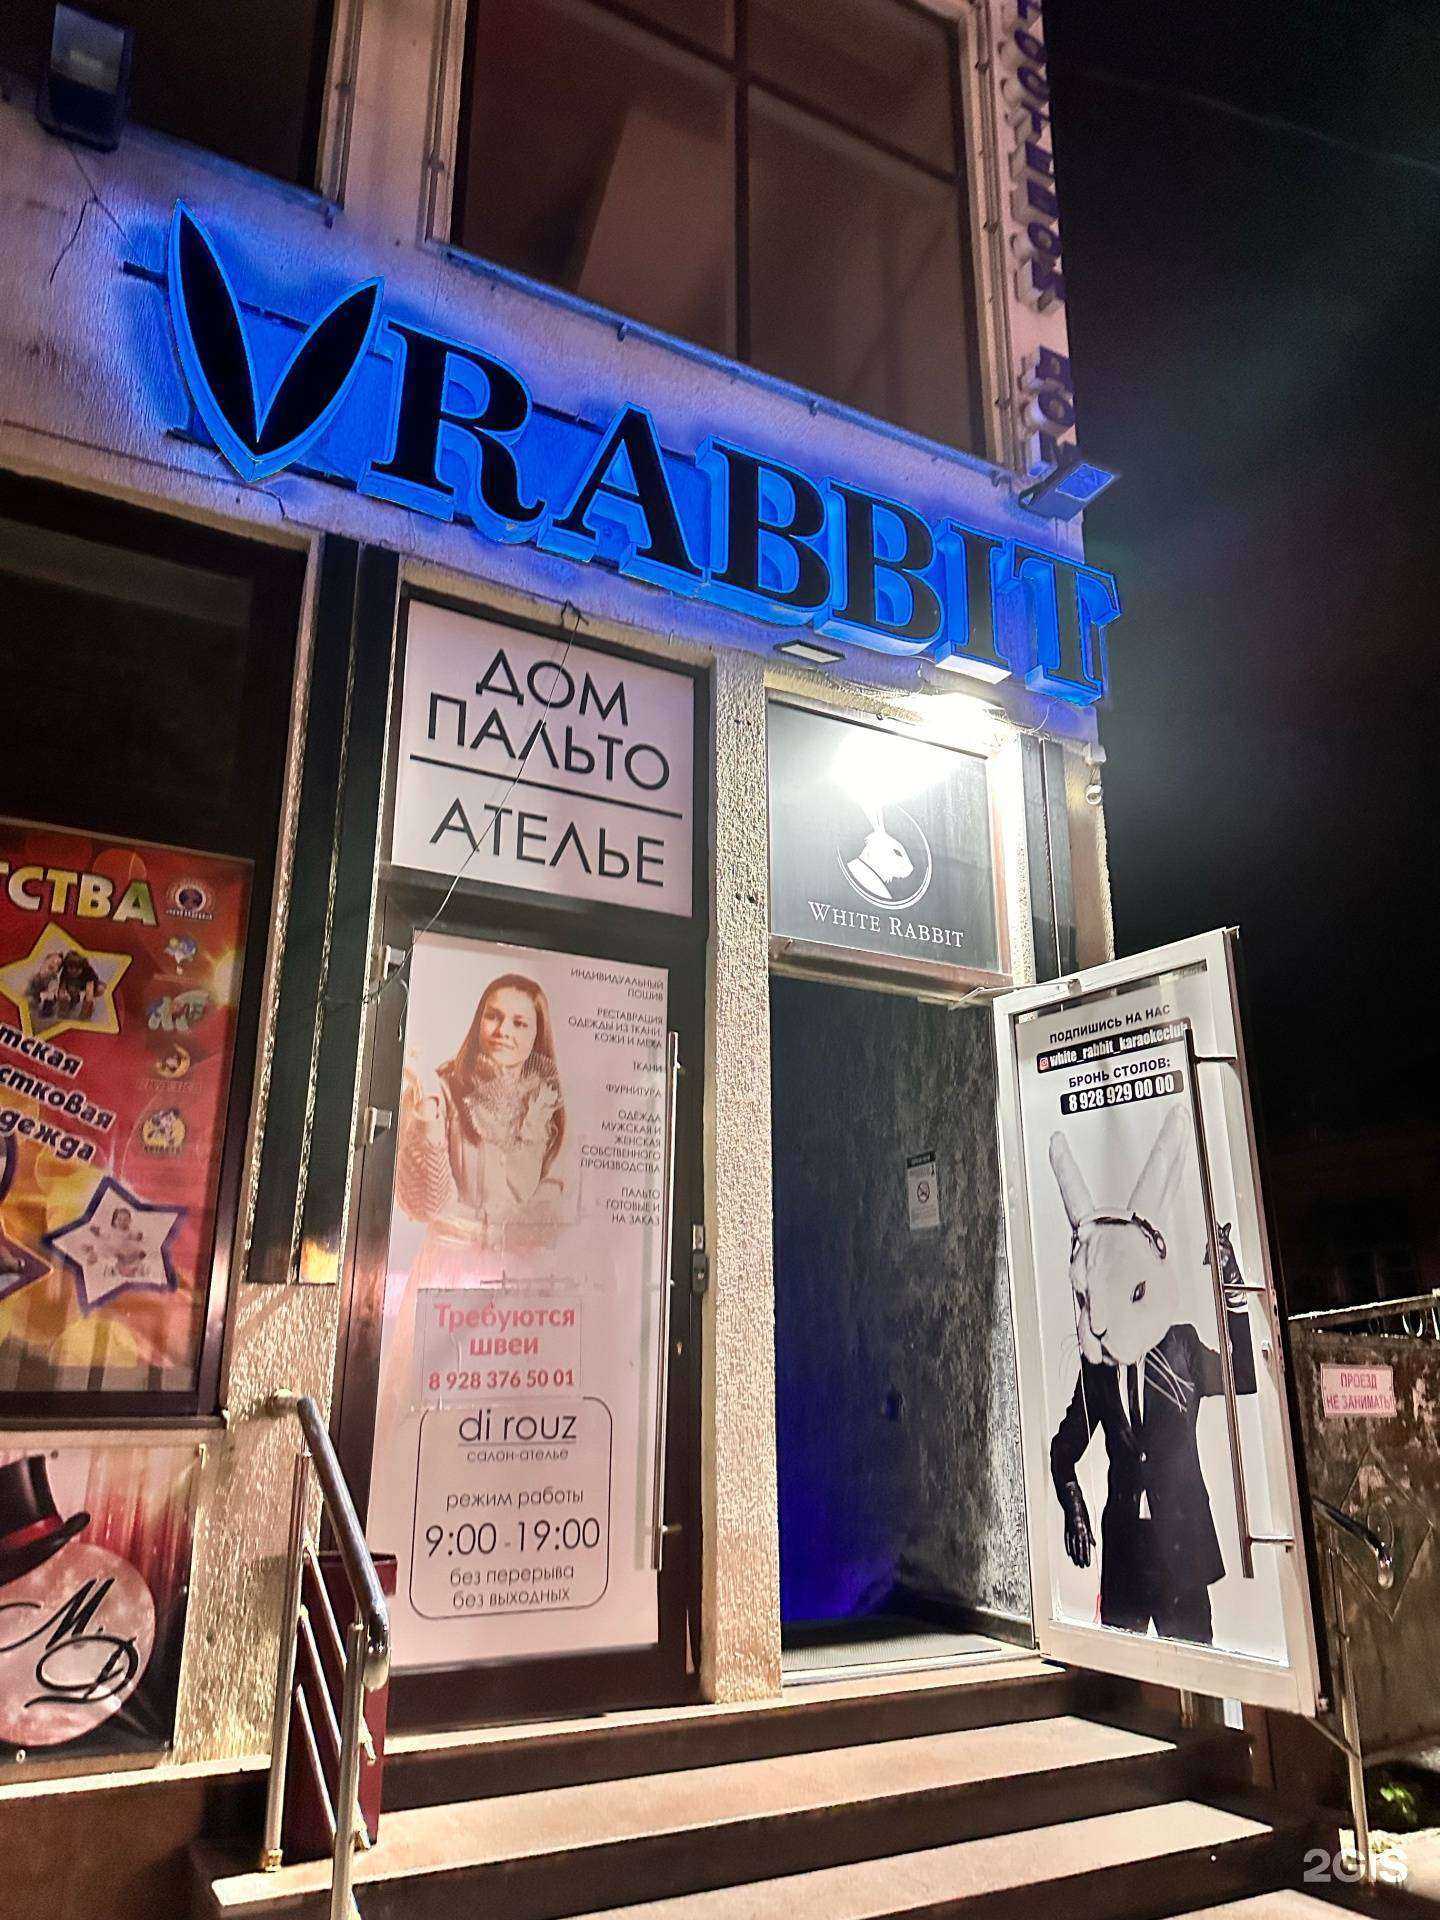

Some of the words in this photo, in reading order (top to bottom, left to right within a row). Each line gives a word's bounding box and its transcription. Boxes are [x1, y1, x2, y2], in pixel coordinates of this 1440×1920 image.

[364, 318, 1120, 702] RABBIT
[475, 648, 629, 727] ДОМ
[427, 691, 670, 791] ПАЛЬТО
[429, 797, 665, 887] АТЕЛЬЕ
[570, 967, 663, 990] ИНДИВИДУАЛЬНЫЙ
[627, 987, 664, 1001] ПОШИВ
[568, 1015, 614, 1031] ОДЕЖДЫ
[616, 1022, 629, 1033] ИЗ
[597, 1007, 663, 1025] РЕСТАВРАЦИЯ
[1049, 1017, 1122, 1044] ПОДПИШИСЬ
[1125, 1012, 1142, 1025] НА
[1145, 1004, 1171, 1020] НАС
[594, 1032, 625, 1045] КОЖИ
[627, 1036, 635, 1046] И
[636, 1037, 662, 1049] МЕХА
[632, 1060, 663, 1073] ТКАНИ
[1068, 1070, 1110, 1089] БРОНЬ
[1113, 1056, 1172, 1079] СТОЛОВ:
[606, 1084, 661, 1098] ФУРНИТУРА
[1068, 1094, 1078, 1112] 8
[1079, 1088, 1105, 1111] 928
[1106, 1082, 1133, 1105] 929
[1134, 1077, 1153, 1099] 00
[1155, 1073, 1175, 1095] 00
[618, 1109, 661, 1122] ОДЕЖДА
[601, 1119, 653, 1135] МУЖСКАЯ
[654, 1125, 662, 1135] И
[614, 1135, 661, 1148] ЖЕНСКАЯ
[581, 1144, 661, 1161] СОБСТВЕННОГО
[579, 1159, 660, 1175] ПРОИЗВОДСТВА
[621, 1186, 661, 1200] ПАЛЬТО
[606, 1199, 650, 1213] ГОТОВЫЕ
[653, 1202, 660, 1213] И
[611, 1212, 626, 1225] НА
[629, 1214, 660, 1226] ЗАКАЗ
[434, 1300, 576, 1334] Требуются
[469, 1336, 539, 1357] швеи
[428, 1370, 441, 1391] 8
[446, 1370, 482, 1390] 928
[486, 1369, 521, 1389] 376
[526, 1368, 549, 1388] 50
[553, 1367, 574, 1388] 01
[1340, 1372, 1378, 1390] ПРОЕЗД
[1326, 1395, 1341, 1410] НЕ
[458, 1407, 492, 1442] di
[503, 1414, 578, 1441] rouz
[466, 1449, 570, 1463] салон-ателье
[446, 1489, 513, 1512] режим
[518, 1486, 584, 1509] работы
[425, 1522, 497, 1559] 9:00
[517, 1517, 600, 1553] 19:00
[449, 1566, 481, 1588] без
[486, 1564, 575, 1587] перерыва
[452, 1589, 484, 1610] без
[489, 1587, 571, 1608] выходных
